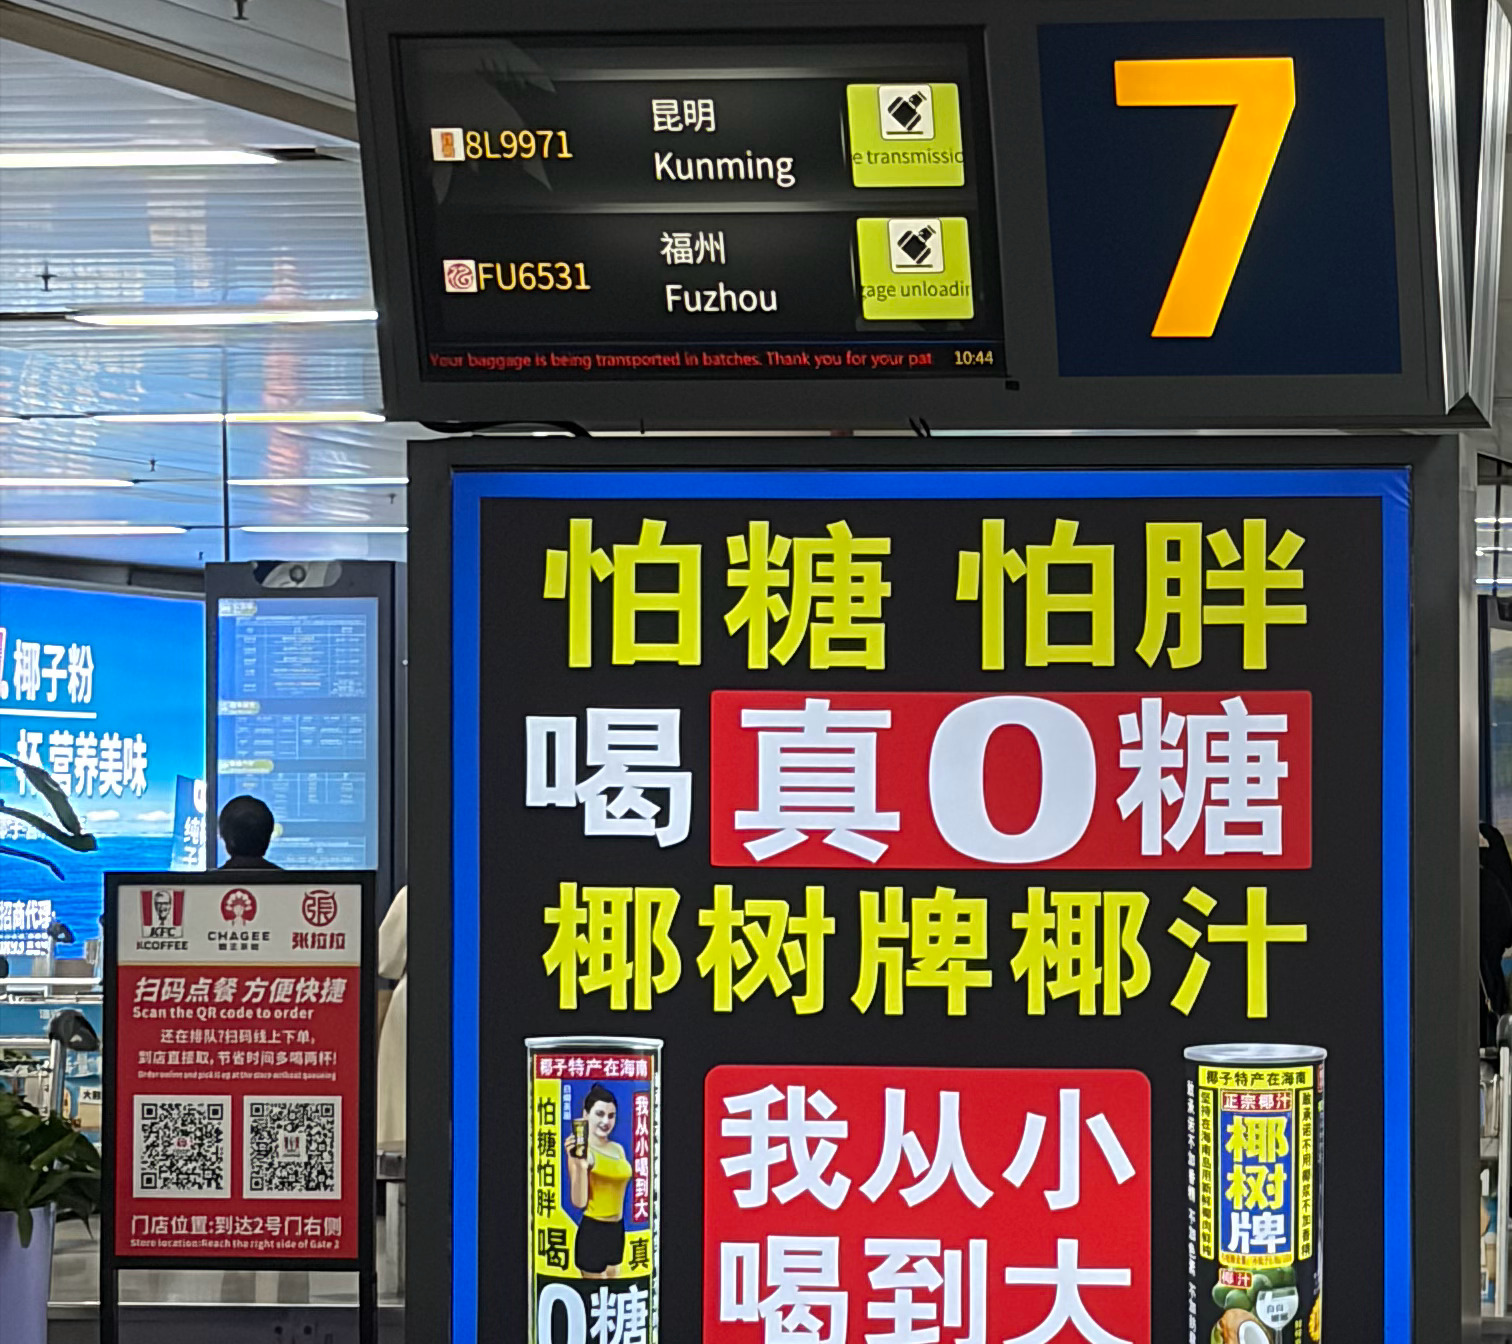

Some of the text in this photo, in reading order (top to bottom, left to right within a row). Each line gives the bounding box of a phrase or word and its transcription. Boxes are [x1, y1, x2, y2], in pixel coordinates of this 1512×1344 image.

[652, 98, 716, 133] 昆明
[465, 130, 573, 159] 8L9971
[654, 150, 796, 188] Kunming
[1115, 56, 1297, 338] 7
[660, 231, 726, 265] 福州
[478, 262, 591, 291] FU6531
[666, 282, 778, 313] Fuzhou
[429, 353, 463, 367] Your
[467, 353, 531, 370] baggage
[535, 353, 547, 367] is
[550, 353, 591, 370] being
[596, 352, 681, 369] transported
[684, 352, 699, 366] in
[767, 351, 810, 366] Thank
[814, 354, 842, 369] you
[846, 350, 867, 366] for
[871, 354, 903, 369] your
[954, 350, 994, 366] 10:44
[542, 517, 893, 670] 怕糖
[955, 517, 1308, 670] 怕胖
[13, 638, 95, 704] 椰子粉
[149, 927, 177, 938] KFC
[207, 931, 271, 942] CHAGEE
[291, 932, 346, 950] 张拉拉
[542, 881, 1310, 1019] 椰树牌椰汁
[134, 976, 348, 1004] 扫码点餐 方便快捷
[132, 1006, 315, 1021] Scan the QR code to order
[1223, 1092, 1292, 1110] 正宗椰汁
[537, 1097, 557, 1219] 怕糖怕胖
[634, 1095, 649, 1220] 我从小喝到大
[718, 1084, 1136, 1212] 我从小
[1225, 1114, 1290, 1255] 椰树牌
[130, 1239, 156, 1248] Store
[538, 1227, 650, 1271] 喝 真
